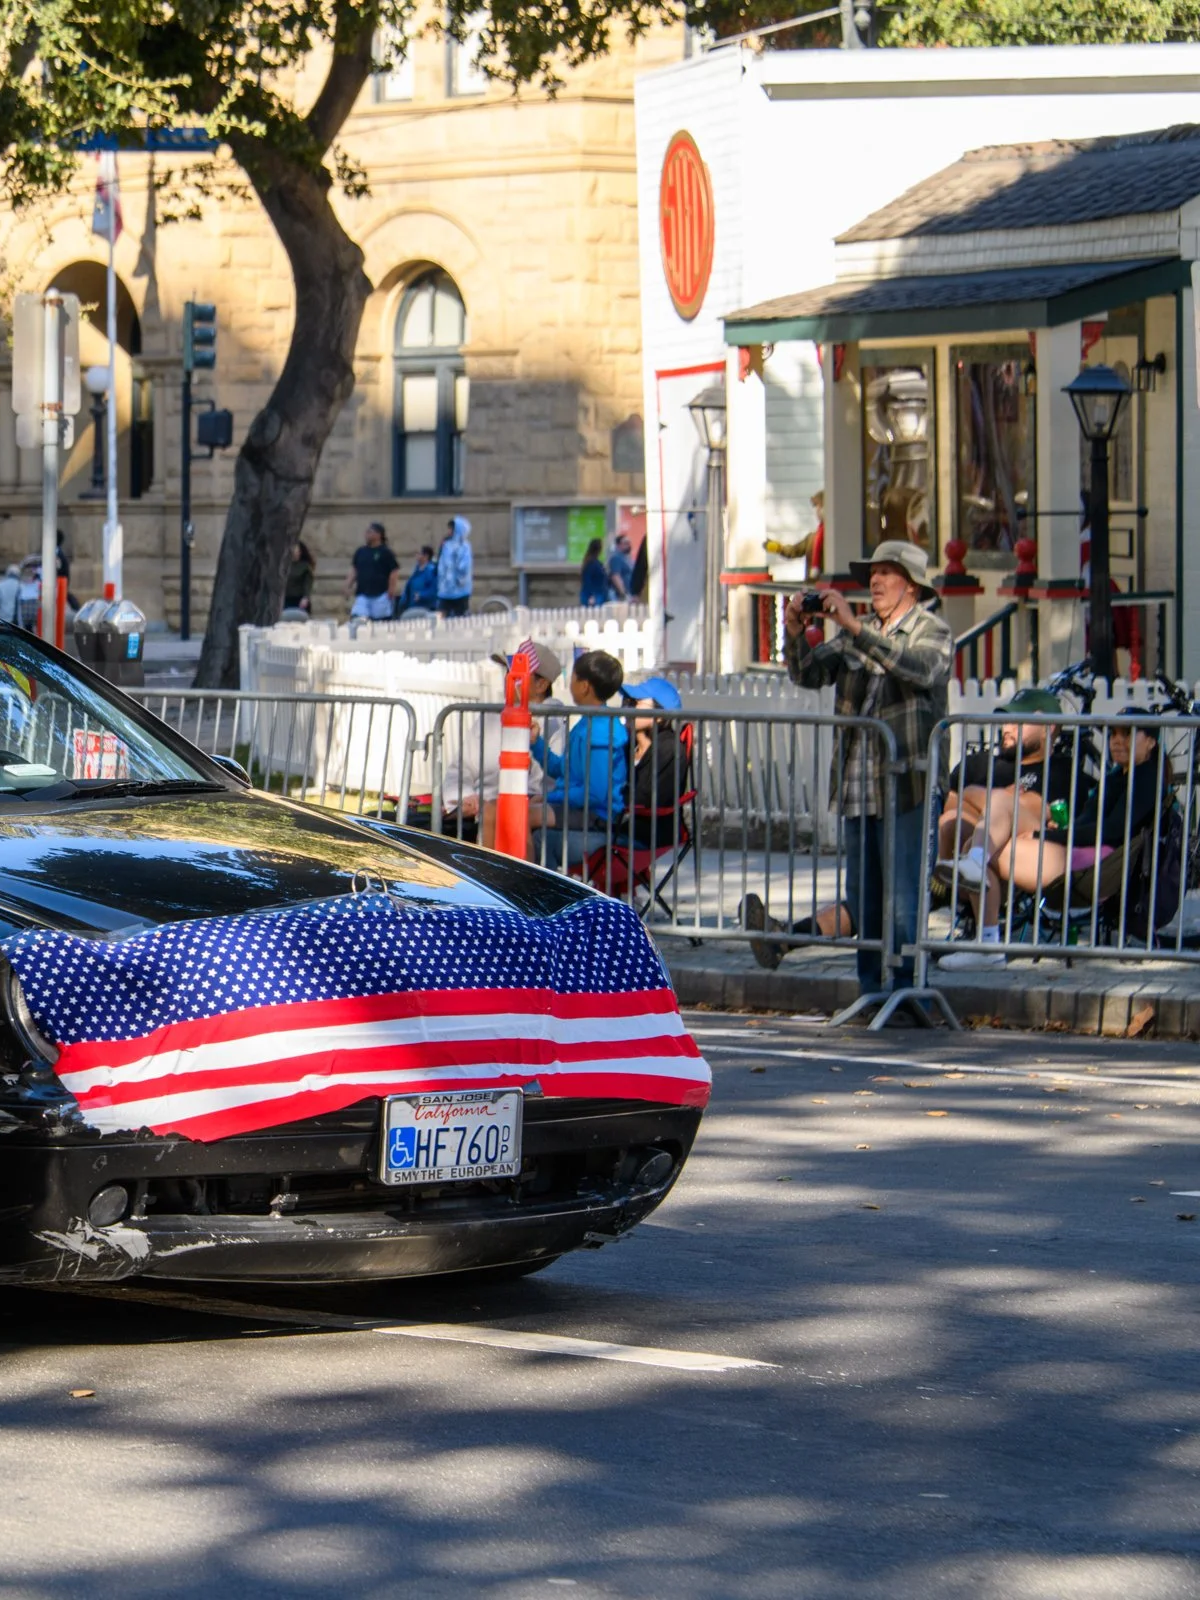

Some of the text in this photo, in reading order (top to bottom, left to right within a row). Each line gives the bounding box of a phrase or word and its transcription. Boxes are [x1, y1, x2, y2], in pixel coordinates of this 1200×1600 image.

[422, 1092, 493, 1104] SAN JOSE
[414, 1103, 497, 1125] California
[394, 1163, 515, 1183] SMYTHE EUROPEAN
